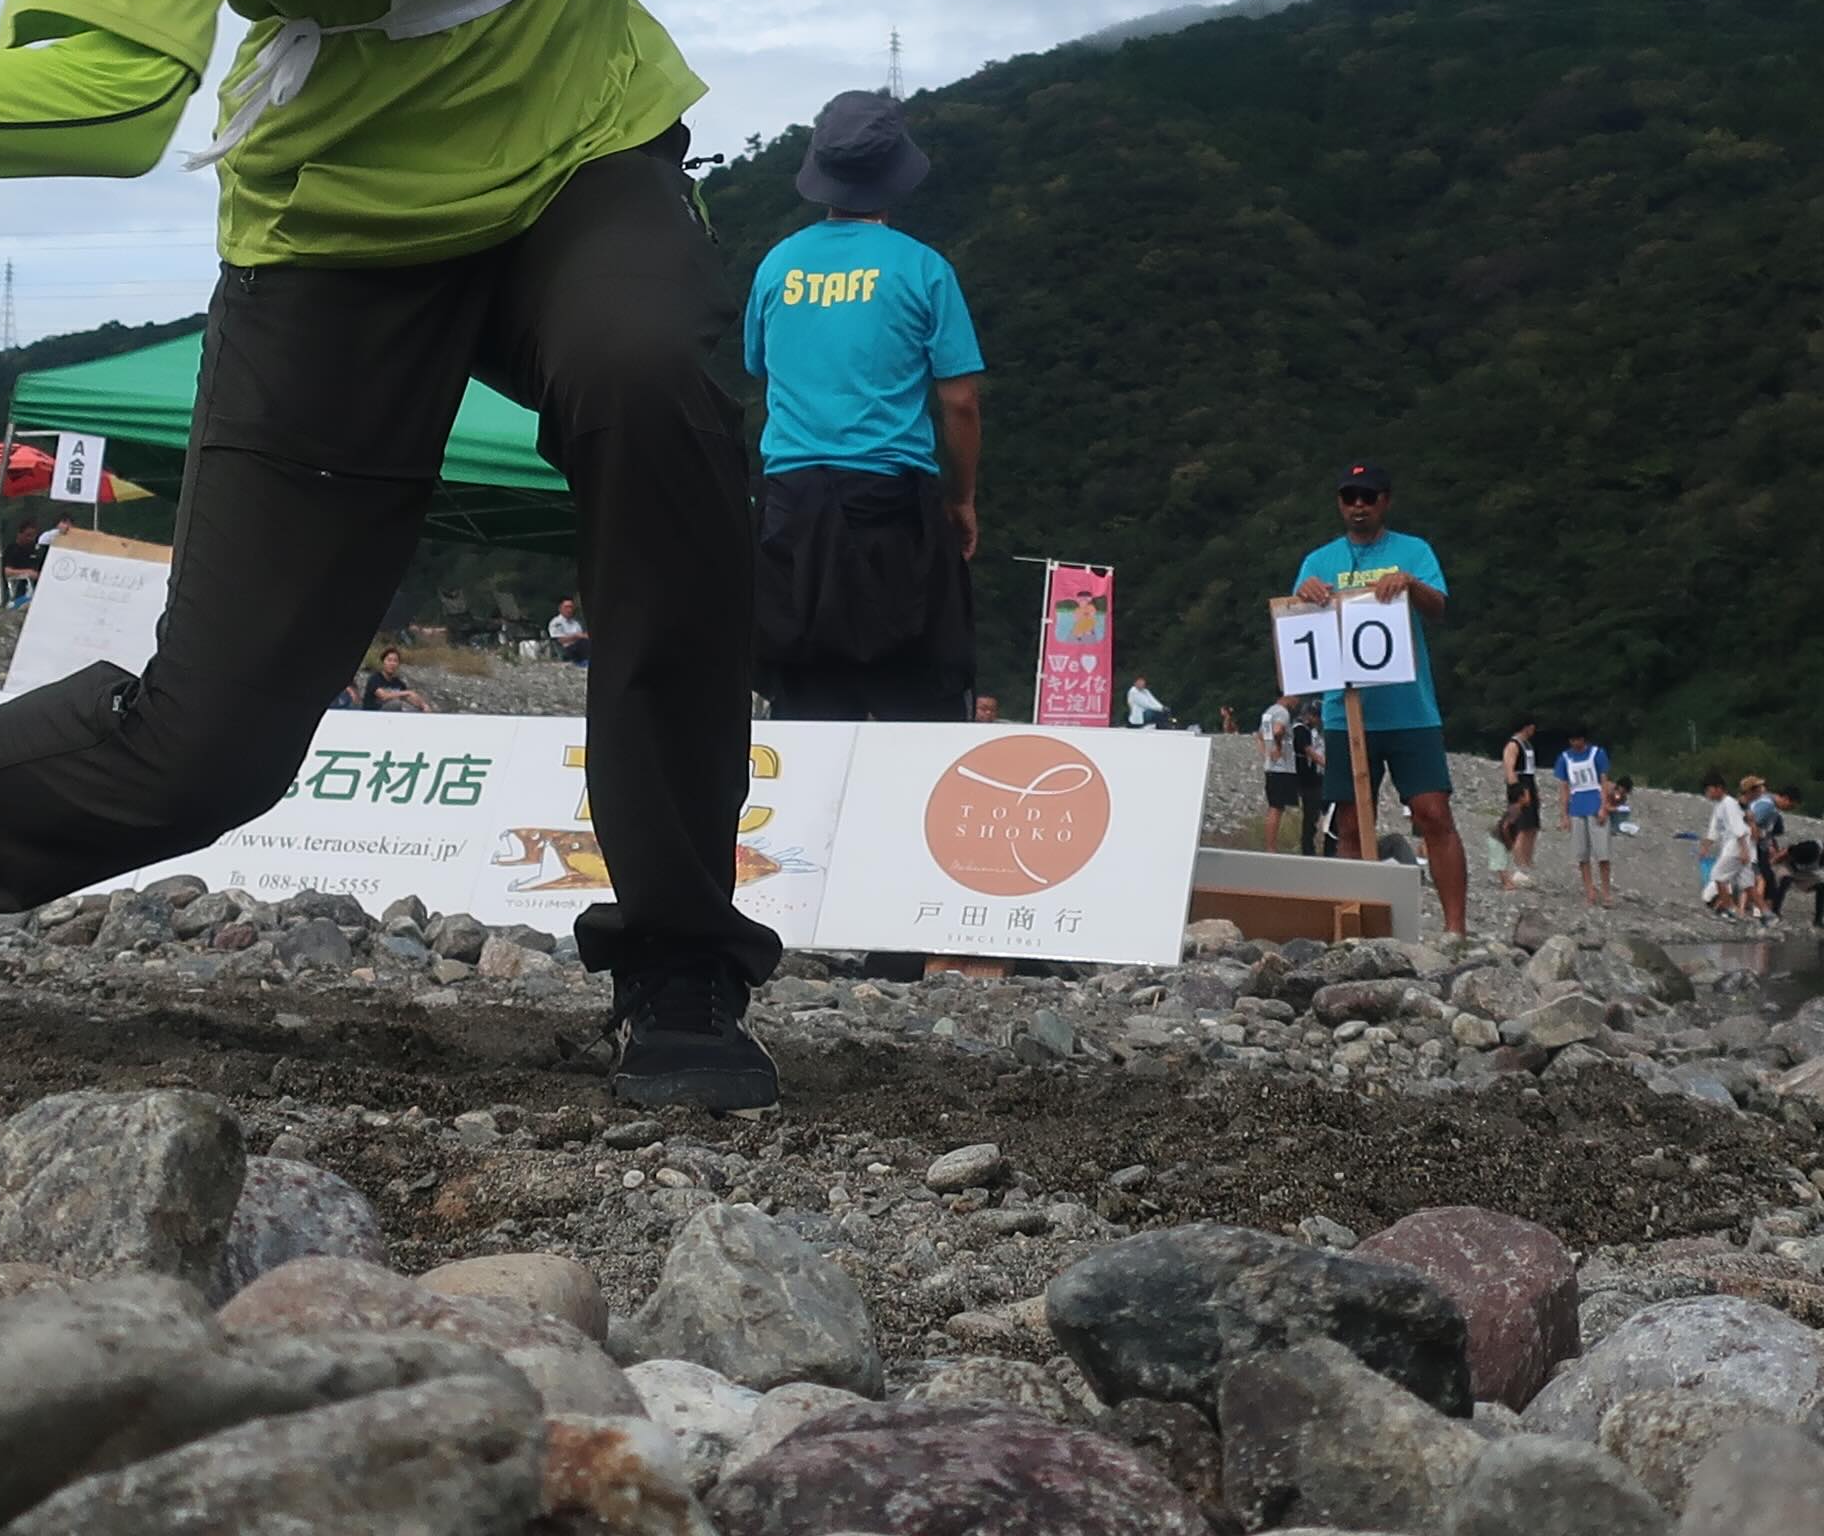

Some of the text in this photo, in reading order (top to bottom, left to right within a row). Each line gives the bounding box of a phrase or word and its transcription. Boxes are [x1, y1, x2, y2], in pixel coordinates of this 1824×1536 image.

[784, 269, 880, 307] STAFF
[1294, 620, 1393, 680] 10
[1048, 655, 1080, 672] We
[1048, 675, 1106, 692] キレイな
[1046, 693, 1102, 713] 仁淀川
[284, 750, 493, 806] 石材店
[961, 805, 1073, 824] TODA
[955, 824, 1072, 843] SHOKO
[259, 873, 381, 894] 088-831-5555
[914, 902, 1083, 934] 戸田商行
